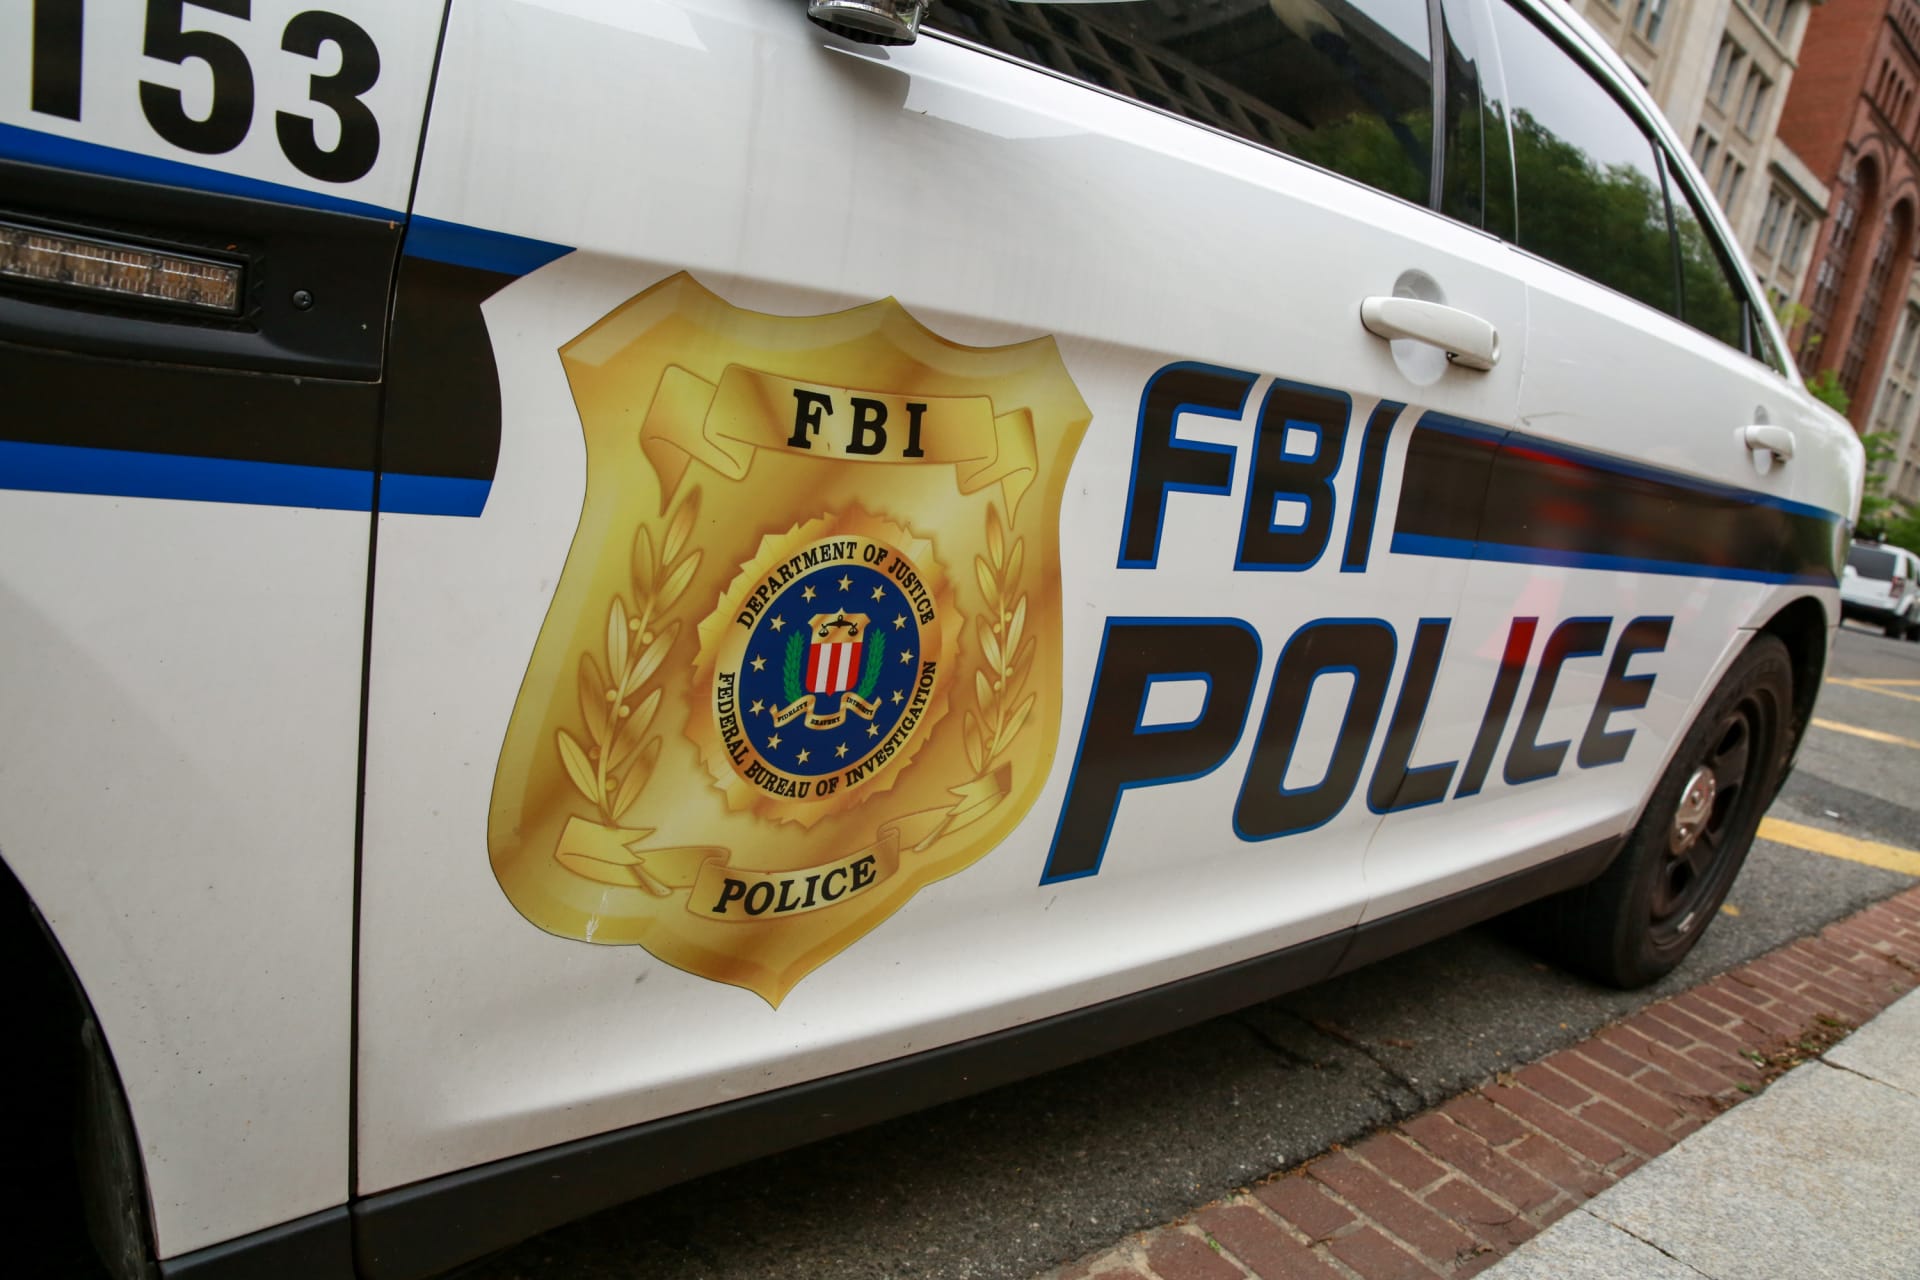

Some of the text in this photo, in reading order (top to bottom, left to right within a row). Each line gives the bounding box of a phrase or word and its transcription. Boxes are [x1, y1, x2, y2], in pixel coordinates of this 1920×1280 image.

[30, 0, 381, 183] 153
[787, 389, 927, 458] FBI
[1116, 361, 1407, 573] FBI
[736, 541, 935, 630] DEPARTMENT OF JUSTICE
[717, 661, 937, 799] FEDERAL BUREAU OF INVESTIGATION
[777, 701, 808, 722] FIDELITY
[1039, 616, 1674, 886] POLICE
[712, 855, 877, 916] POLICE
